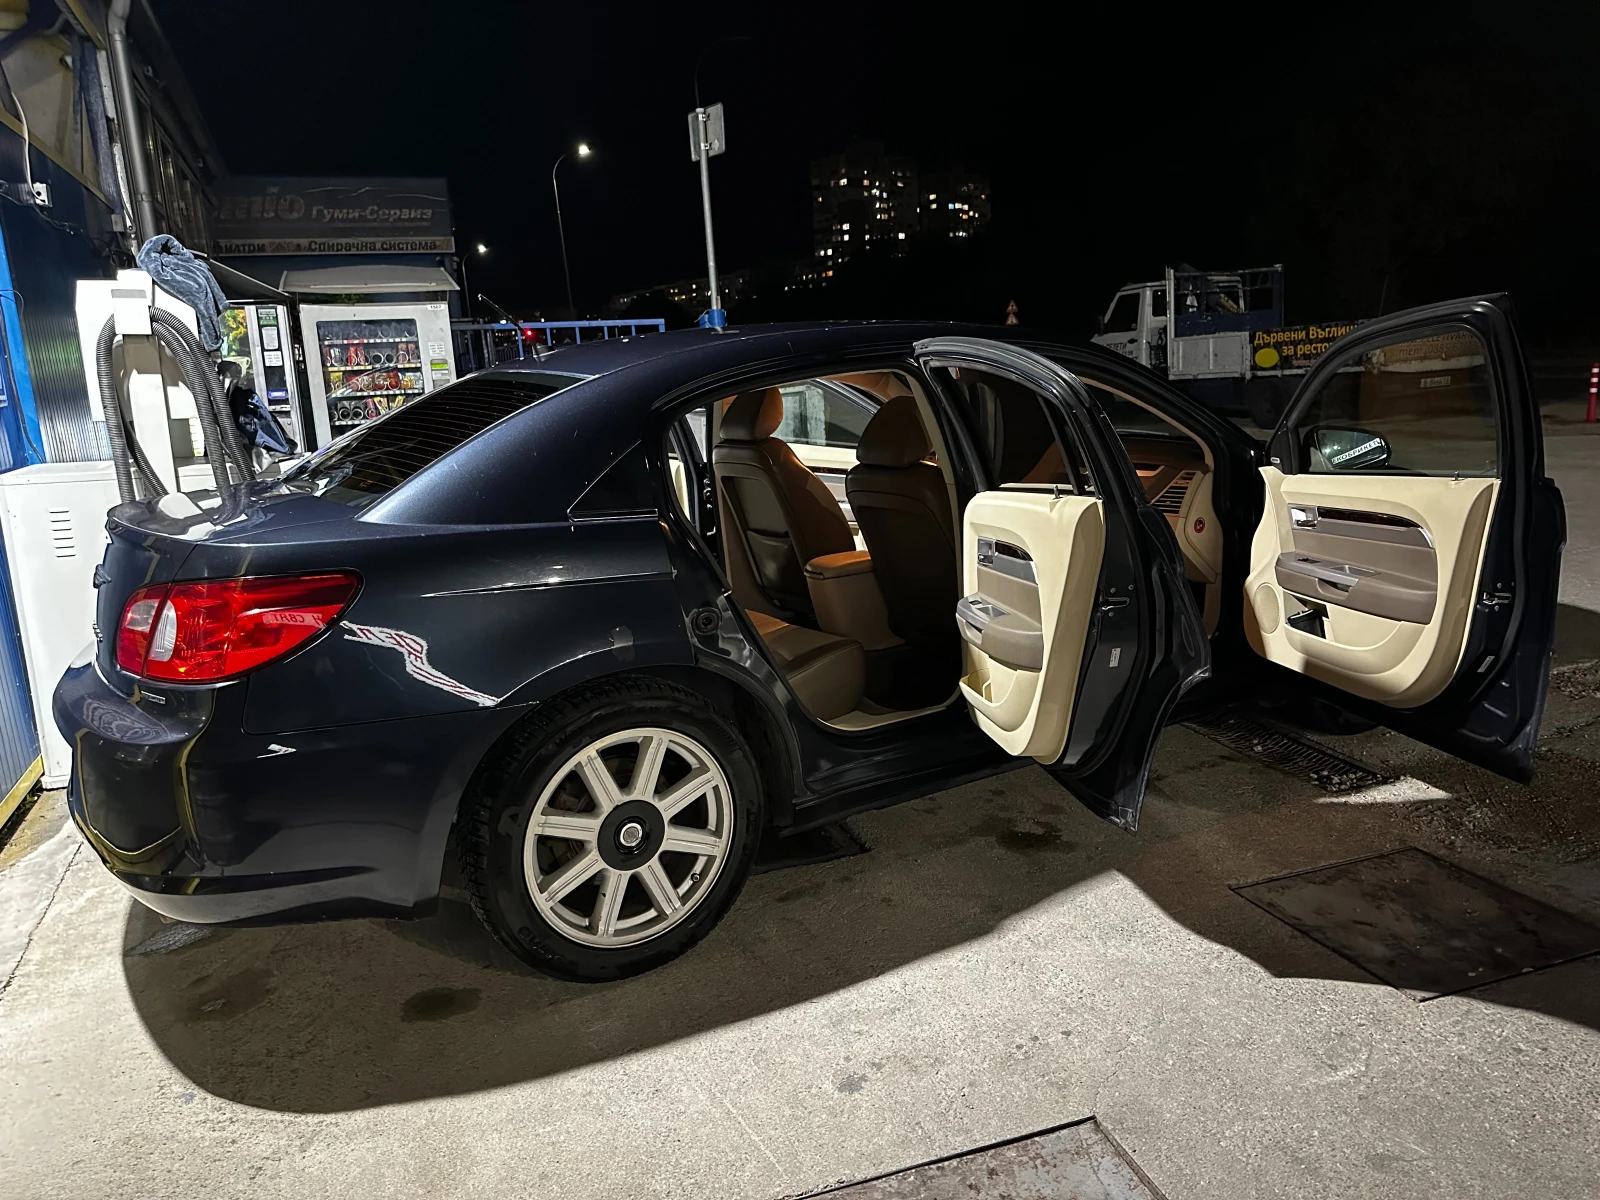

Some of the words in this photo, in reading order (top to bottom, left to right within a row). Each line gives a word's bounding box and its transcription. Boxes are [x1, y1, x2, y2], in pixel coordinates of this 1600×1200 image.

[308, 239, 377, 252] Спирачна
[1254, 329, 1306, 346] Дървени
[1282, 346, 1295, 356] за
[1297, 342, 1333, 357] ресто
